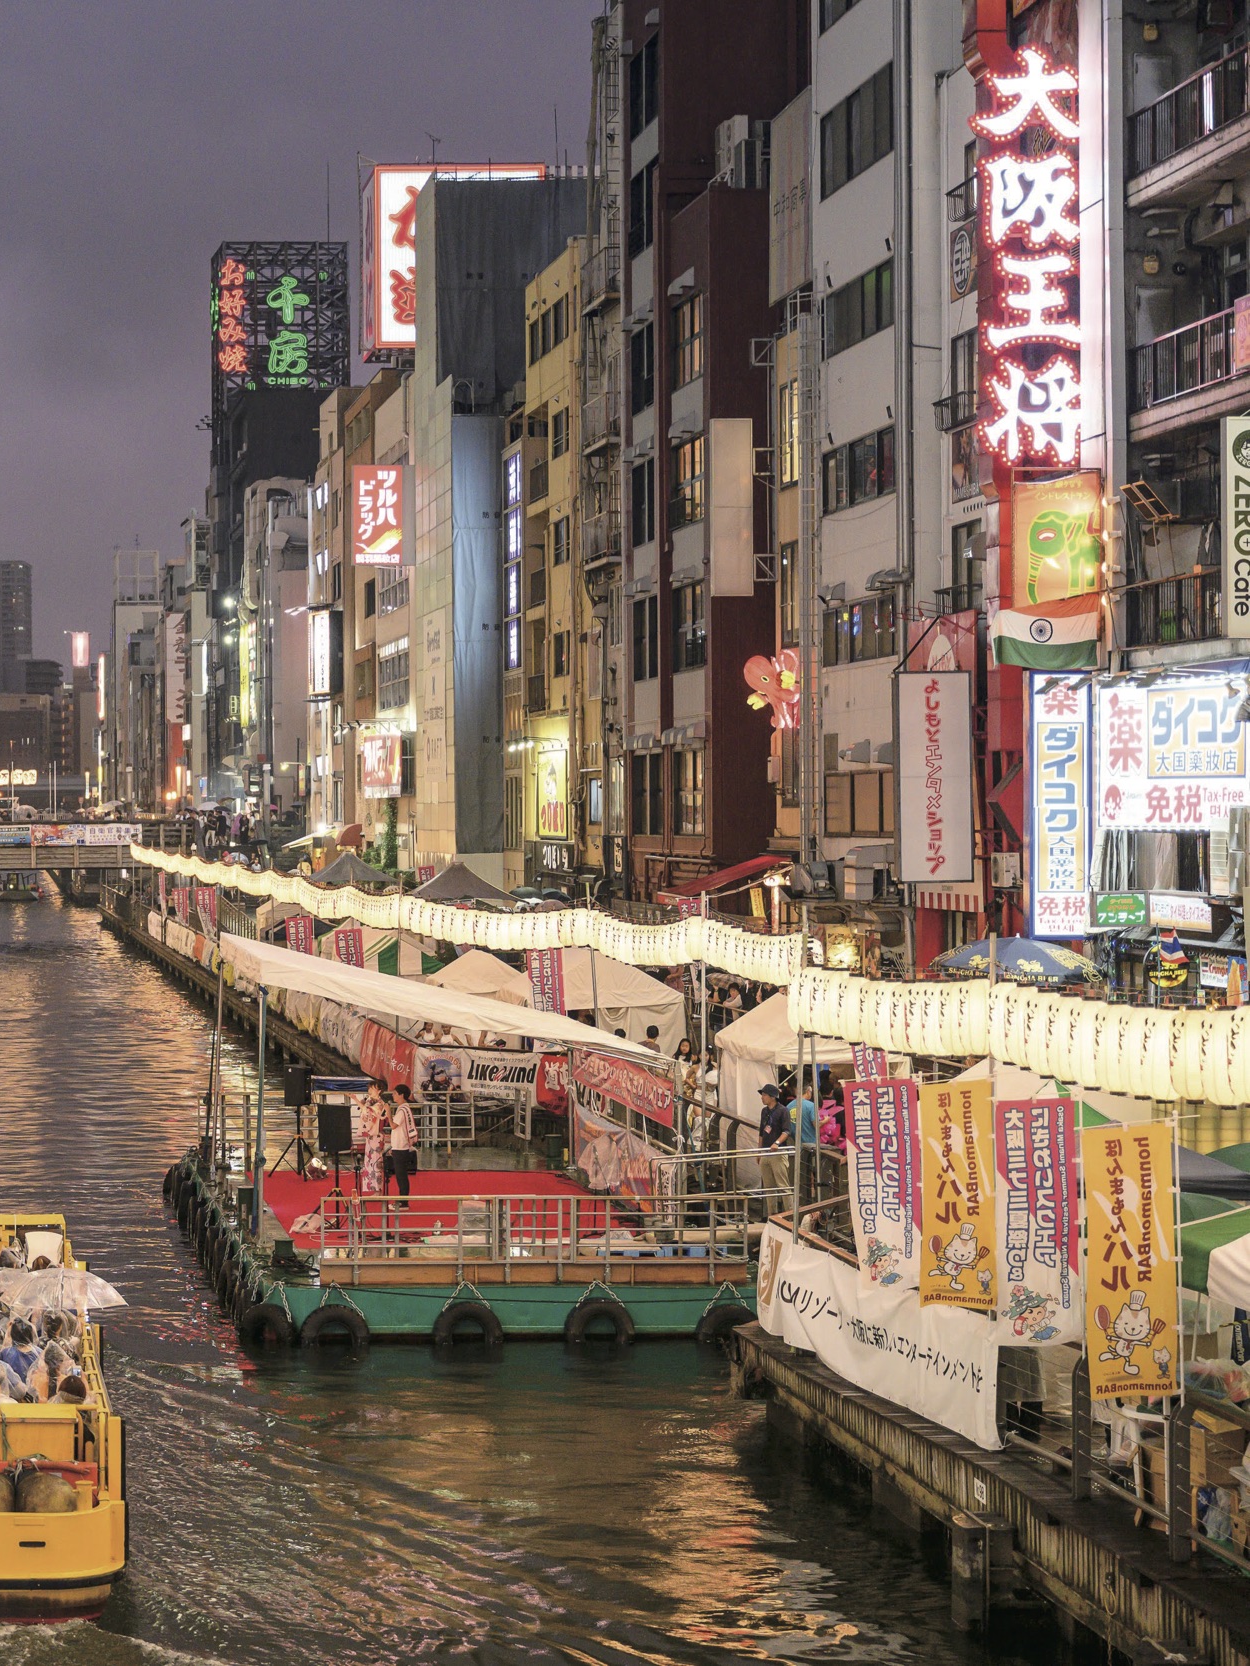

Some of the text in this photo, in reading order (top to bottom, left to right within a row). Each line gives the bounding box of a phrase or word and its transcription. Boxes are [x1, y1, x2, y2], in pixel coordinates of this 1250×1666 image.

[969, 46, 1080, 467] 大阪王将
[219, 259, 247, 372] お好み焼
[267, 277, 310, 374] 千房
[358, 480, 376, 540] ドラッグ
[377, 471, 398, 526] ツルハ
[924, 679, 945, 875] よしもとエンタメショップ
[1043, 726, 1078, 833] ダイコク
[1145, 784, 1203, 823] 免税
[1202, 787, 1244, 803] Tax-Free
[1038, 896, 1086, 917] 免税
